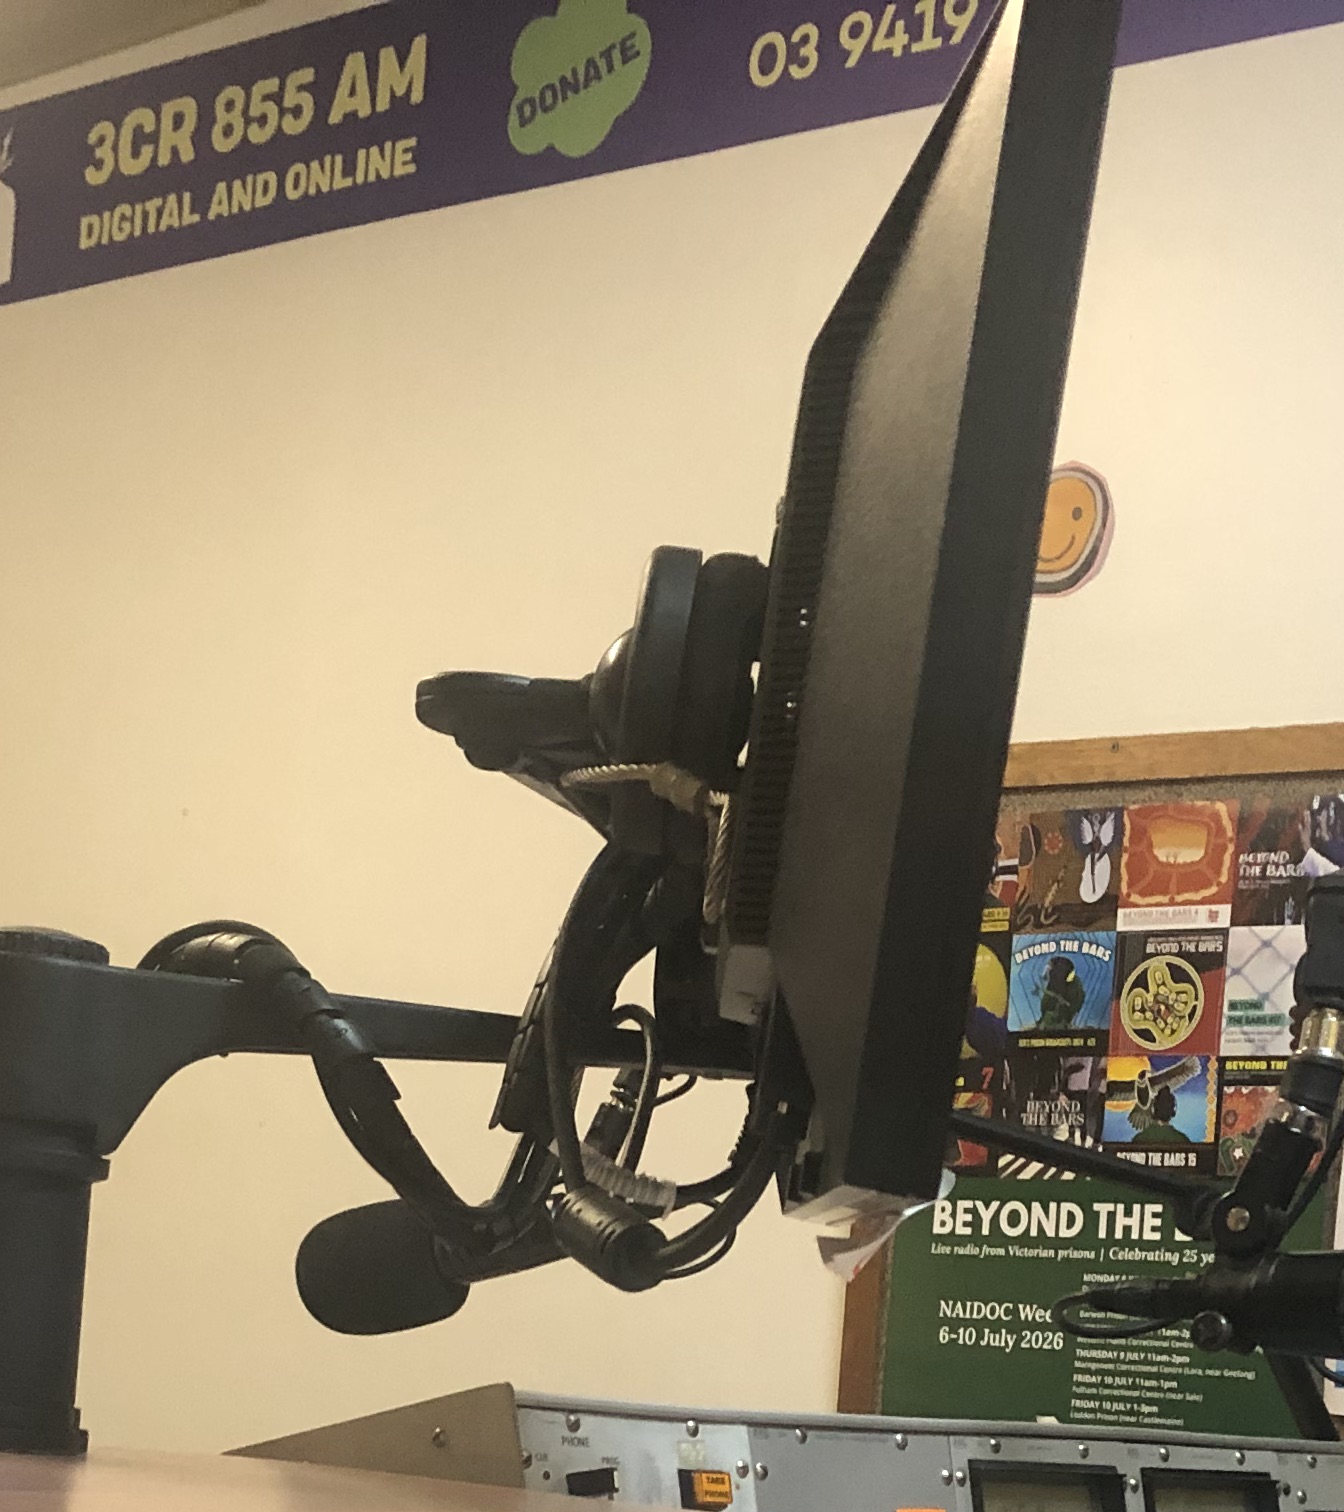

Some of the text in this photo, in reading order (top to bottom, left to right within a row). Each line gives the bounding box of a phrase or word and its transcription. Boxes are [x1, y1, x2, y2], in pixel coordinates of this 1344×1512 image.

[749, 0, 978, 88] 03 9419
[515, 30, 642, 129] DONATE
[84, 33, 427, 186] 3CR 855 AM
[79, 137, 418, 250] DIGITAL AND ONLINE
[1239, 850, 1290, 864] BEYOND
[1239, 864, 1262, 877] THE
[1015, 940, 1112, 964] BEYOND THE BARS
[1146, 940, 1224, 954] BEYOND THE BARS
[1225, 1060, 1268, 1070] BEYOND
[1026, 1100, 1081, 1114] BEYOND
[1021, 1111, 1085, 1127] THE BARS
[1148, 1152, 1163, 1167] THE
[1164, 1153, 1186, 1167] BARS
[932, 1200, 1084, 1238] BEYOND
[1093, 1202, 1163, 1241] THE
[930, 1243, 1198, 1266] Live radio from Victorian prisons Celebrating 25
[939, 1300, 1052, 1323] NAIDOC Wee
[939, 1326, 1064, 1353] 6-10 July 2026
[1076, 1349, 1118, 1360] THURSDAY
[1073, 1374, 1102, 1385] FRIDAY
[1071, 1399, 1100, 1410] FRIDAY
[561, 1436, 590, 1447] PHONE
